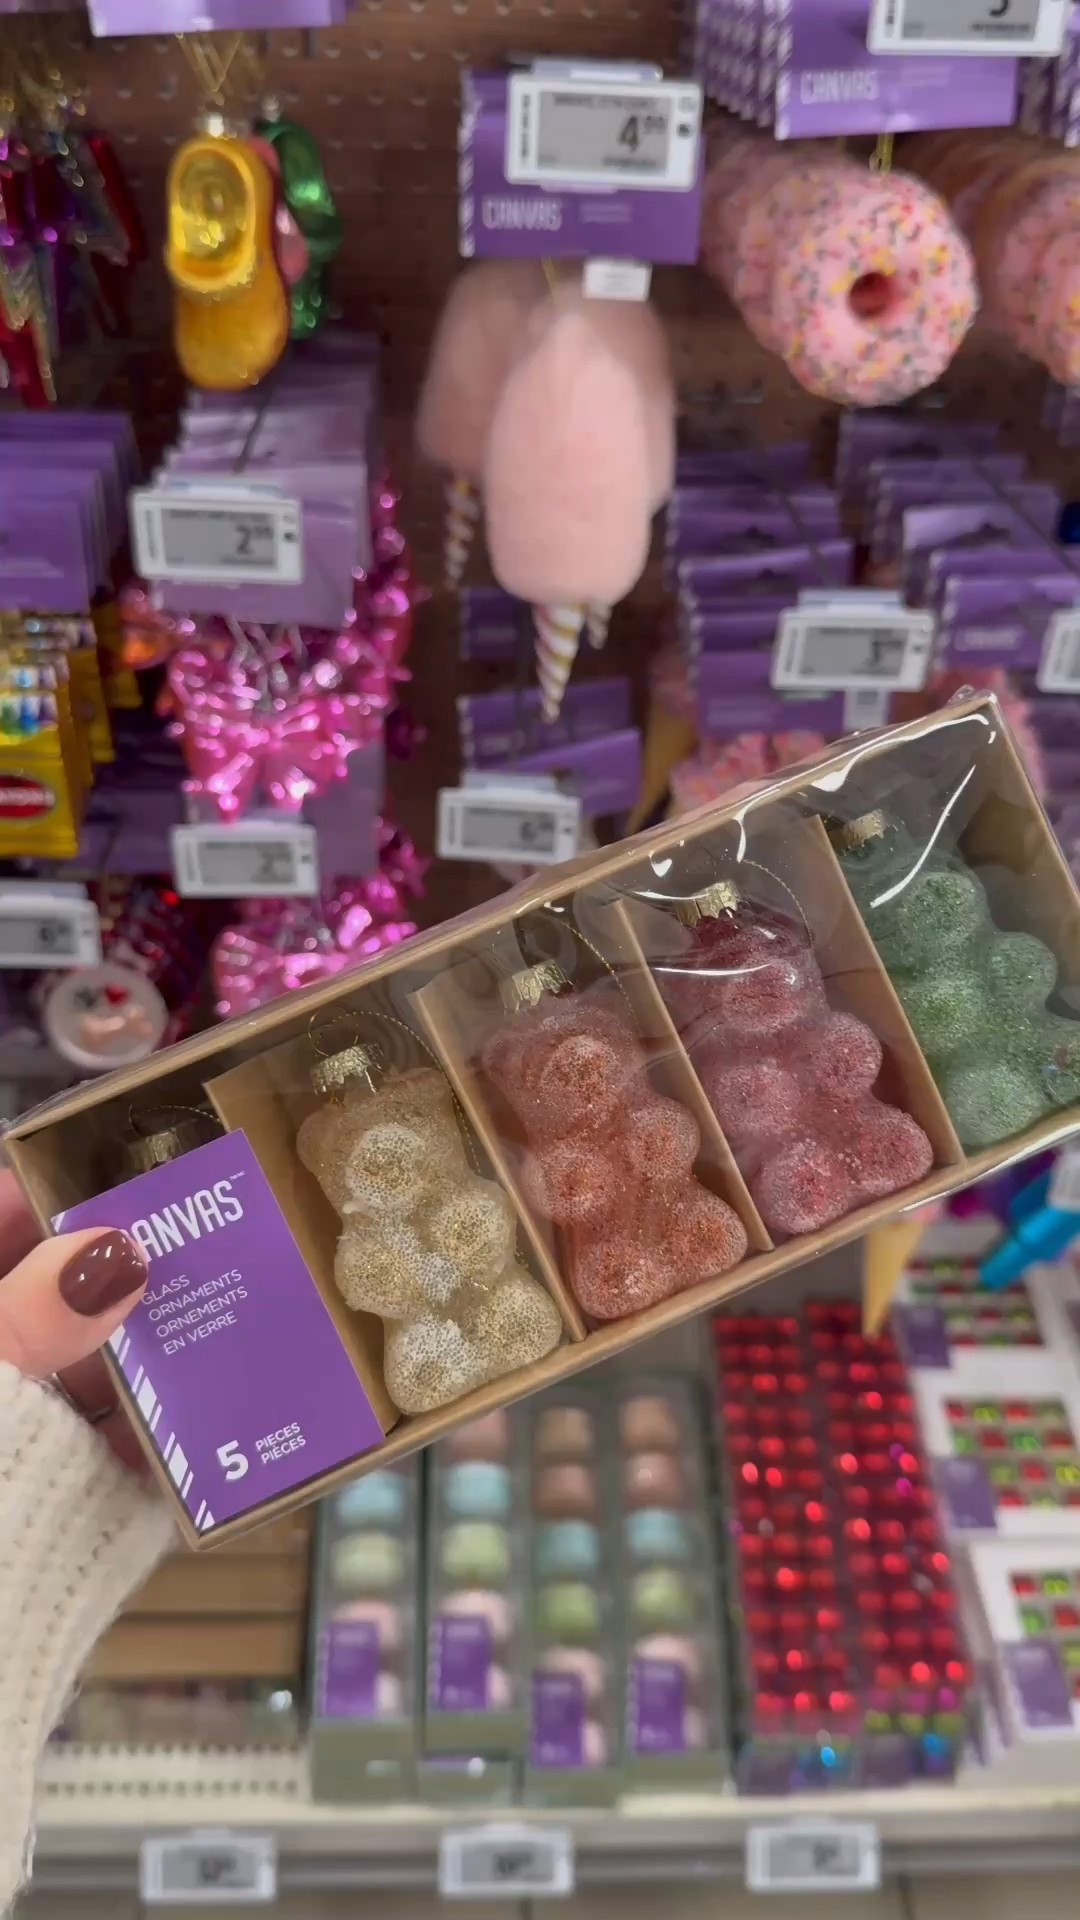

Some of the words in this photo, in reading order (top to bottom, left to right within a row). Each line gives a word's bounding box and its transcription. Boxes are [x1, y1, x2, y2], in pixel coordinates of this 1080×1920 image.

[801, 69, 878, 104] CANVAS
[481, 197, 563, 231] CANVAS
[120, 1180, 244, 1263] ANVAS
[141, 1274, 190, 1305] GLASS
[148, 1269, 242, 1321] ORNAMENTS
[156, 1286, 248, 1338] ORNEMENTS
[163, 1336, 186, 1355] EN
[186, 1310, 239, 1342] VERRE
[255, 1422, 301, 1452] PIECES
[260, 1435, 307, 1464] PIÈCES
[216, 1439, 249, 1481] 5
